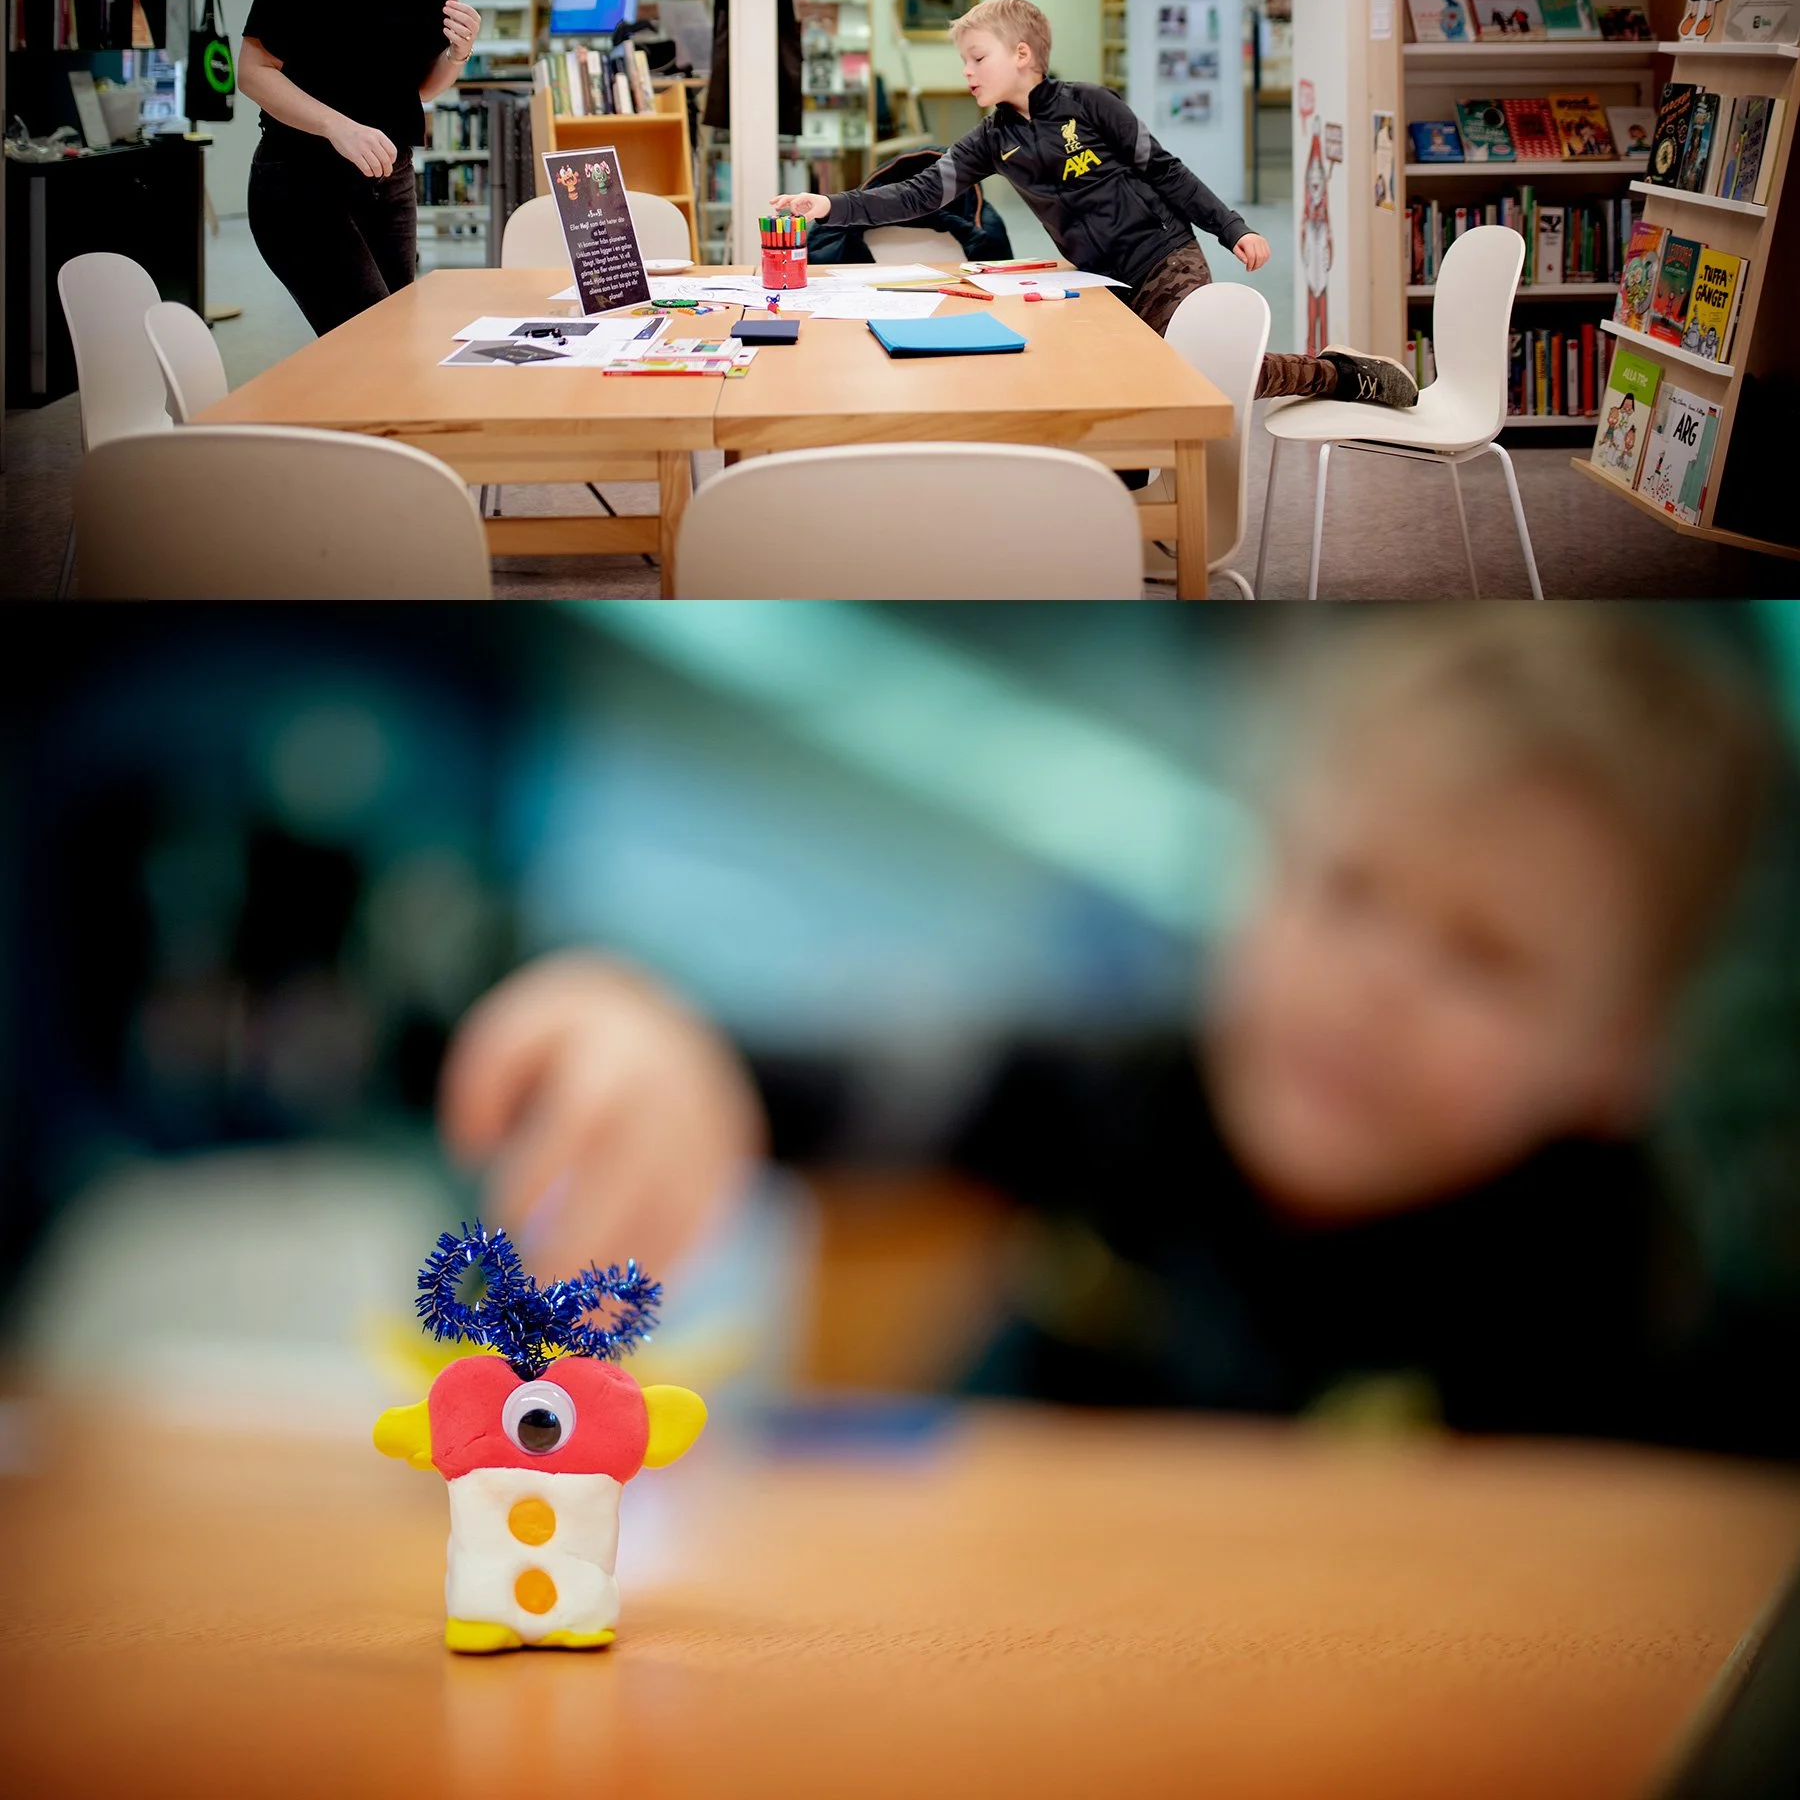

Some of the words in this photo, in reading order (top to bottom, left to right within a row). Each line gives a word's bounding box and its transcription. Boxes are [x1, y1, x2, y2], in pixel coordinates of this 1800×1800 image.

[1062, 148, 1102, 181] AXA
[583, 239, 599, 247] kommer
[609, 235, 626, 243] planeten
[600, 246, 612, 255] ligger
[580, 270, 594, 278] gärna
[620, 271, 632, 279] skapa
[632, 270, 640, 278] nya
[1703, 264, 1727, 287] TUFFA
[625, 280, 631, 288] på
[1695, 284, 1729, 309] GÄNGET
[1672, 412, 1699, 447] ARG
